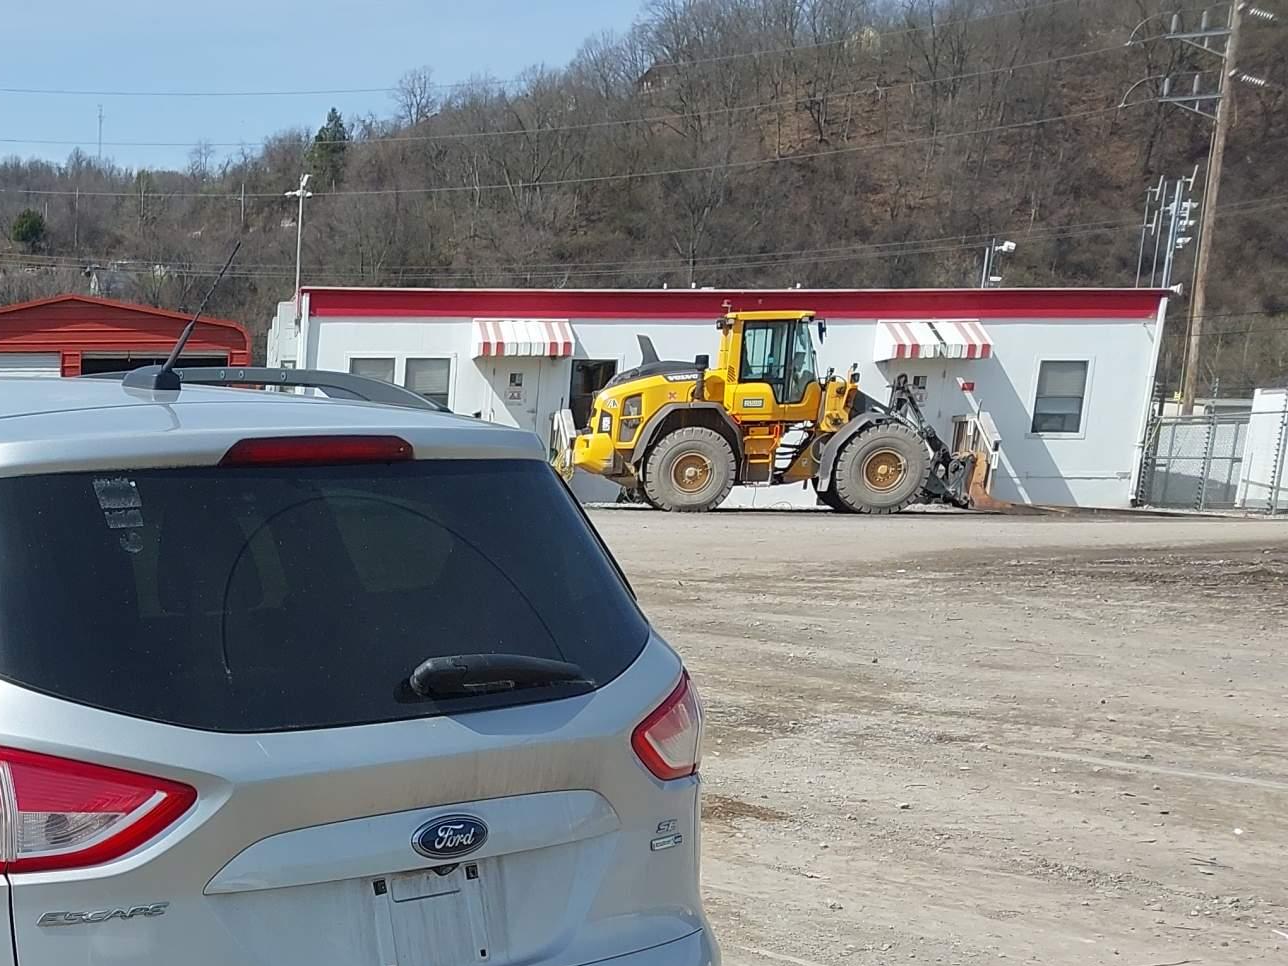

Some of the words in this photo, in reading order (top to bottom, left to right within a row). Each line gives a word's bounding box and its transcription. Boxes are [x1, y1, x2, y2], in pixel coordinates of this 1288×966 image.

[666, 373, 699, 381] VOLVO
[434, 824, 475, 849] Ford
[36, 901, 170, 927] ESCAPE
